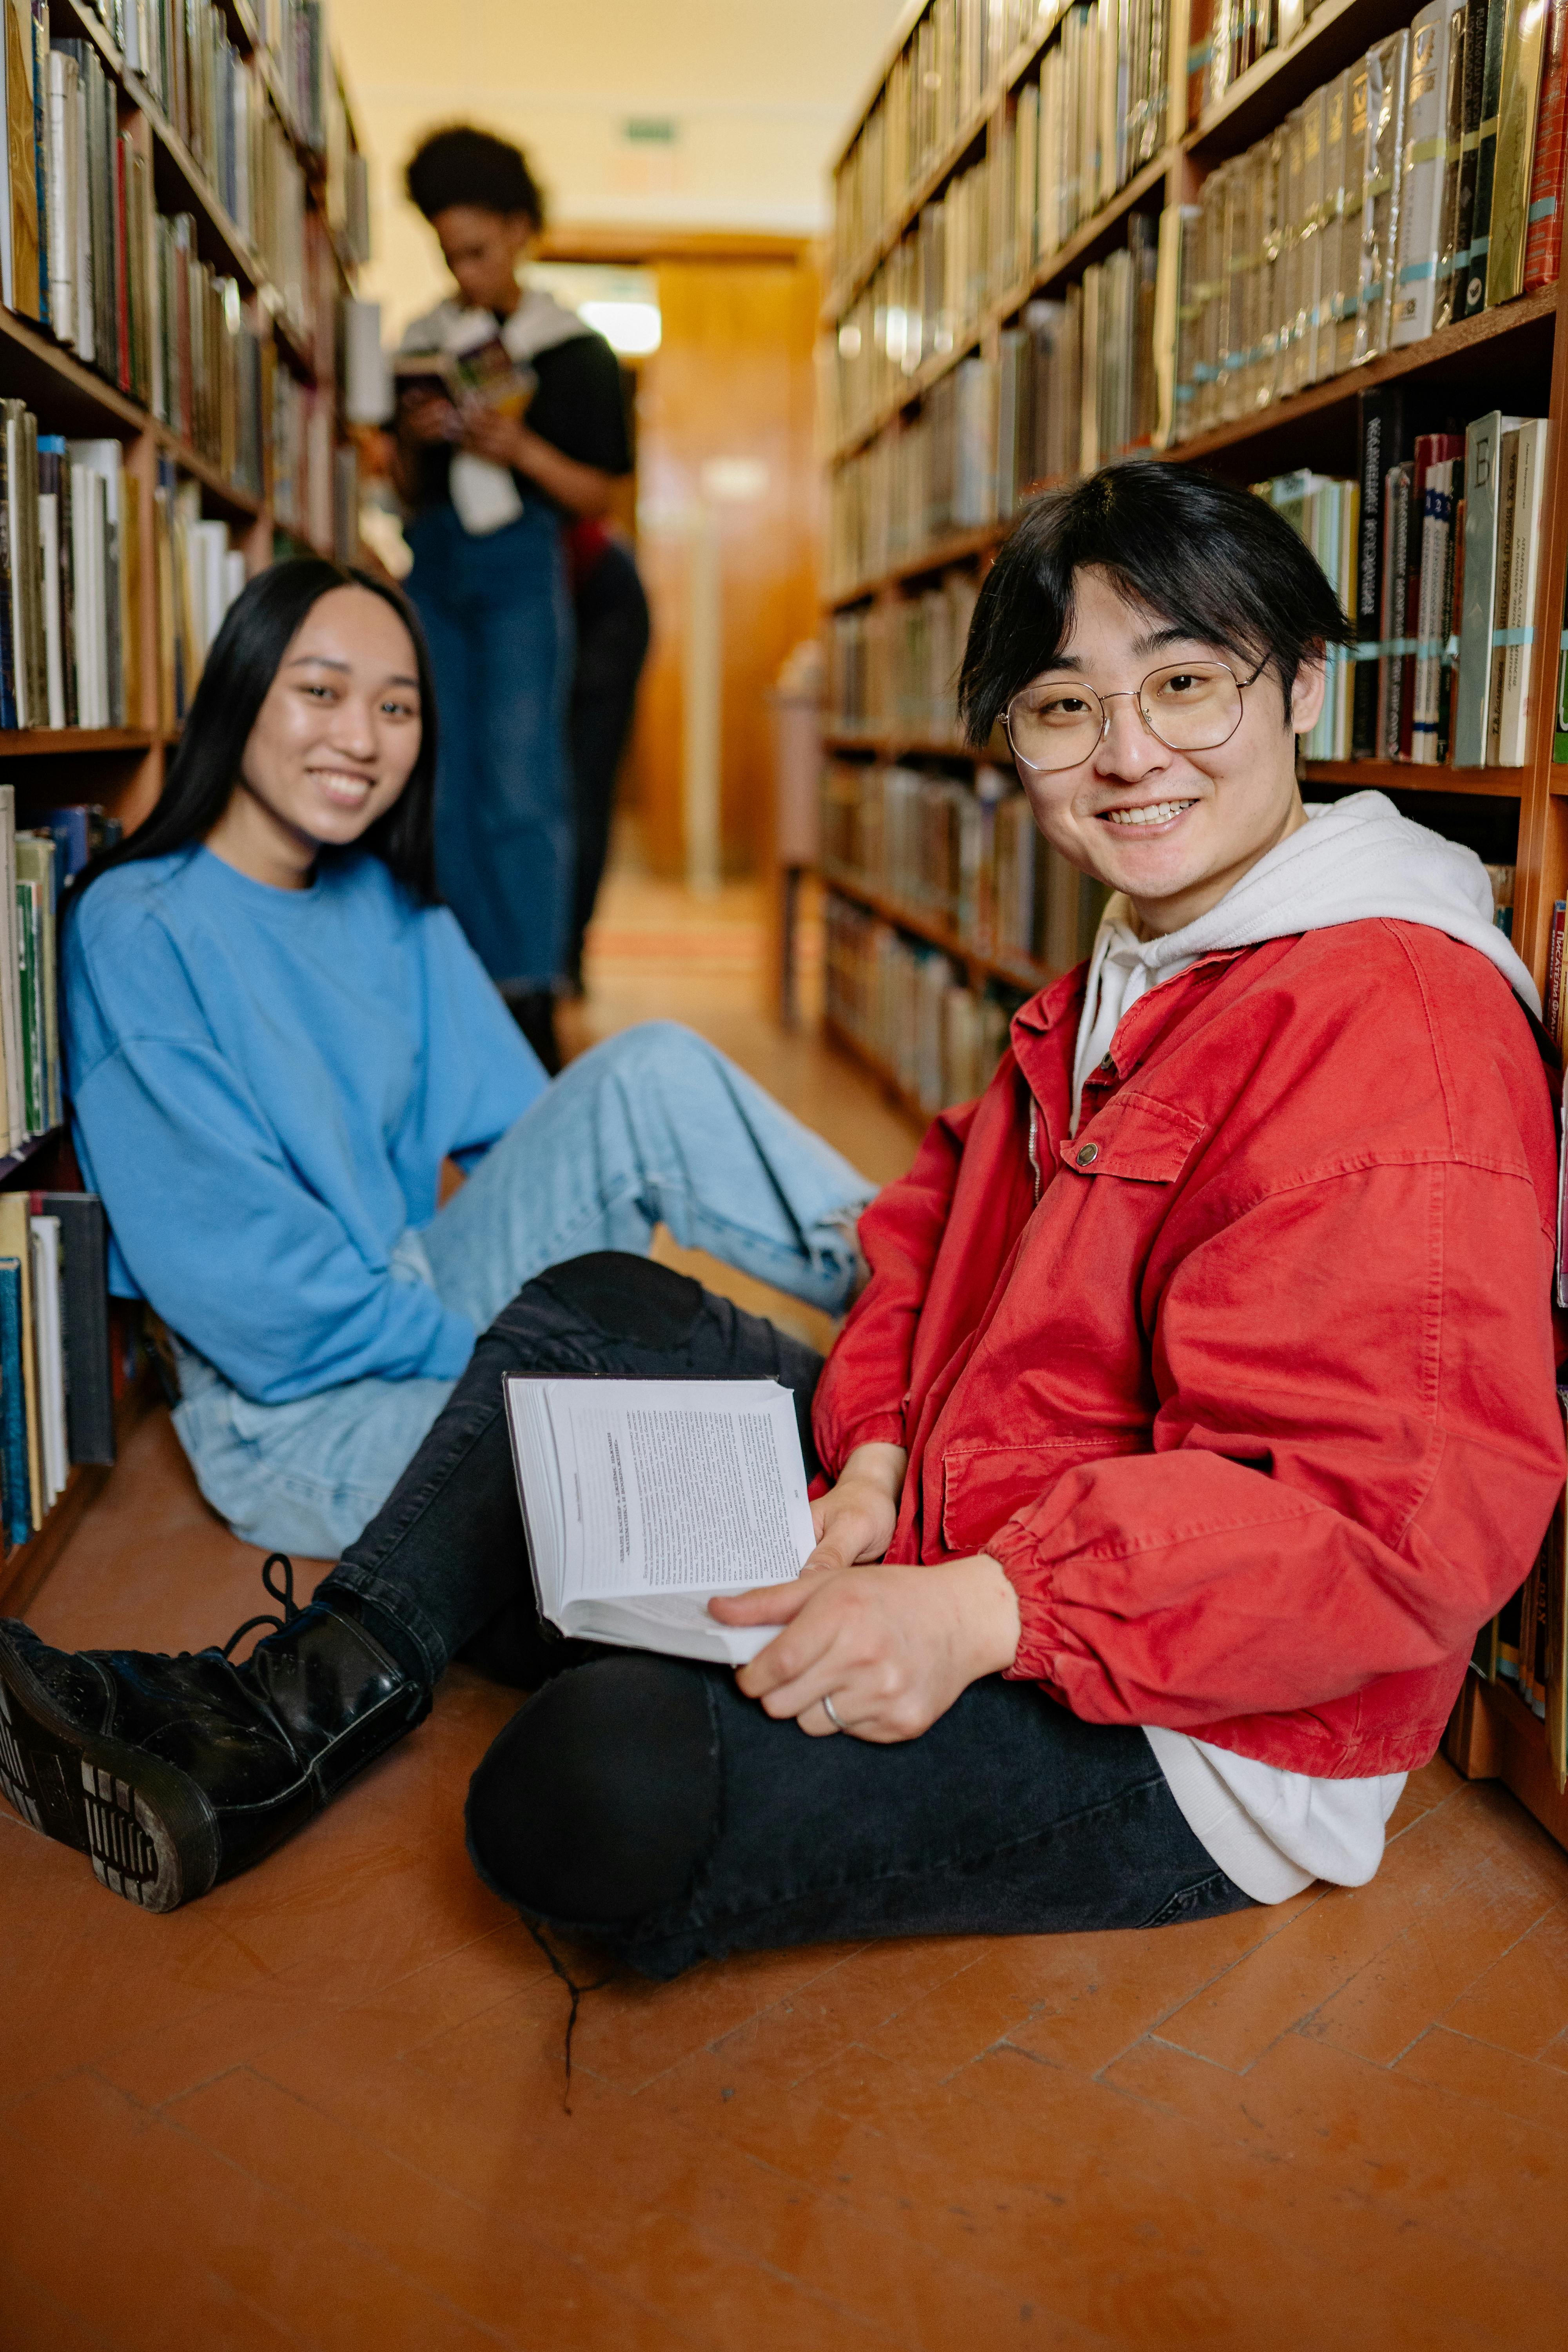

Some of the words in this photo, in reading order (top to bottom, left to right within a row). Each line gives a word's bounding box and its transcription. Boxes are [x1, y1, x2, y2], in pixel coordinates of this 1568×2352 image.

[1435, 499, 1442, 513] 2
[1553, 931, 1564, 998] ПИСАТЕЛИ
[1550, 1000, 1559, 1039] ФРАН
[698, 1411, 706, 1444] математика
[747, 1413, 755, 1443] множества
[607, 1432, 615, 1463] НЬЮМЕН
[703, 1445, 712, 1474] обширная
[715, 1427, 726, 1465] противостоят
[739, 1427, 749, 1466] бесконечного
[754, 1426, 764, 1463] пространства
[763, 1427, 773, 1465] бесконечного
[613, 1439, 625, 1494] ВООБРАЖЕНИЕ»
[751, 1445, 762, 1483] бесконечного
[764, 1462, 775, 1495] Гиперсфера
[724, 1475, 733, 1508] математика
[761, 1465, 772, 1511] четырехмерного
[772, 1479, 781, 1505] гиперкуб
[776, 1466, 785, 1499] существуют
[716, 1485, 724, 1517] тавтология
[742, 1497, 753, 1535] пространства
[721, 1519, 730, 1548] обширная
[730, 1516, 741, 1553] воображение
[739, 1506, 748, 1538] математика
[768, 1512, 778, 1542] Геометрия
[769, 1539, 777, 1570] множества
[777, 1539, 786, 1564] свойства
